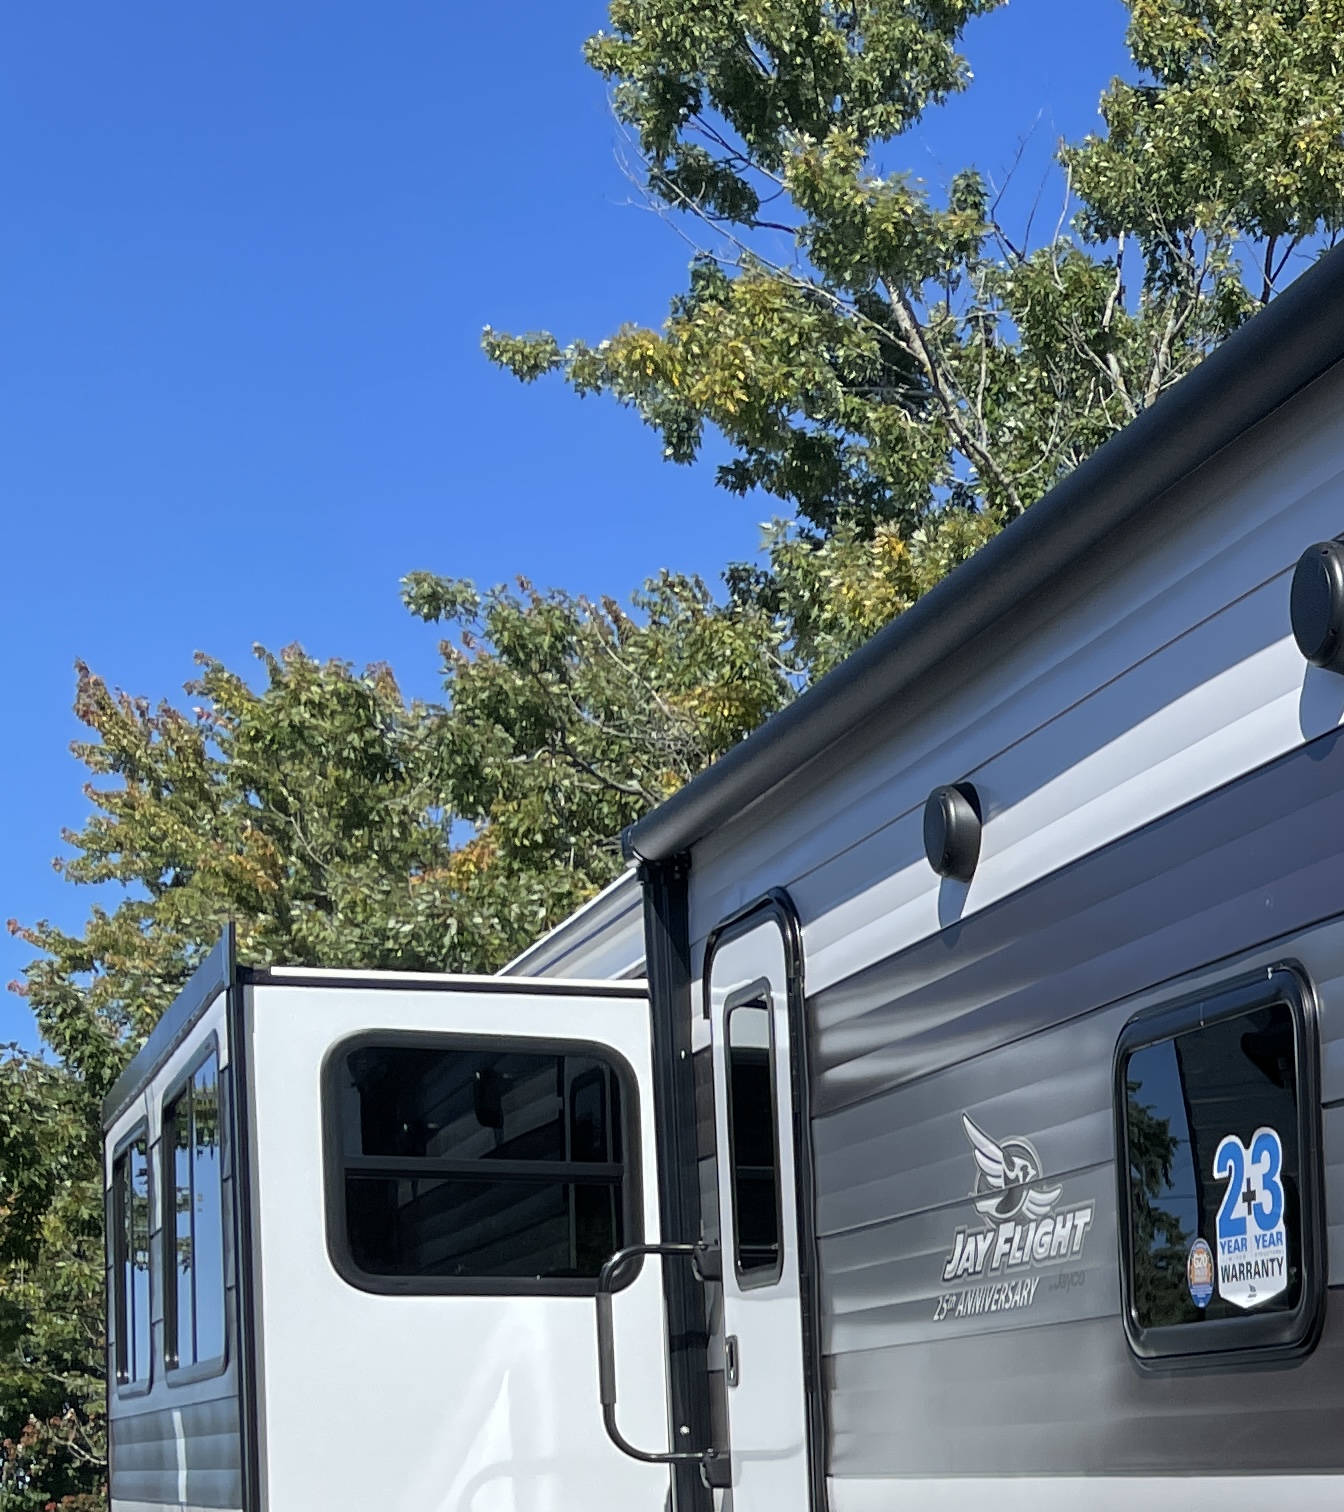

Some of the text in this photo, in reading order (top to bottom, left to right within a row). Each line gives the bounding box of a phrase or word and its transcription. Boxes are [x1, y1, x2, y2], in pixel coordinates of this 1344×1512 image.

[943, 1208, 1092, 1280] JAY FLIGHT
[1220, 1231, 1284, 1255] YEAR YEAR
[1221, 1256, 1284, 1284] WARRANTY
[955, 1276, 1040, 1318] ANNIVERSARY
